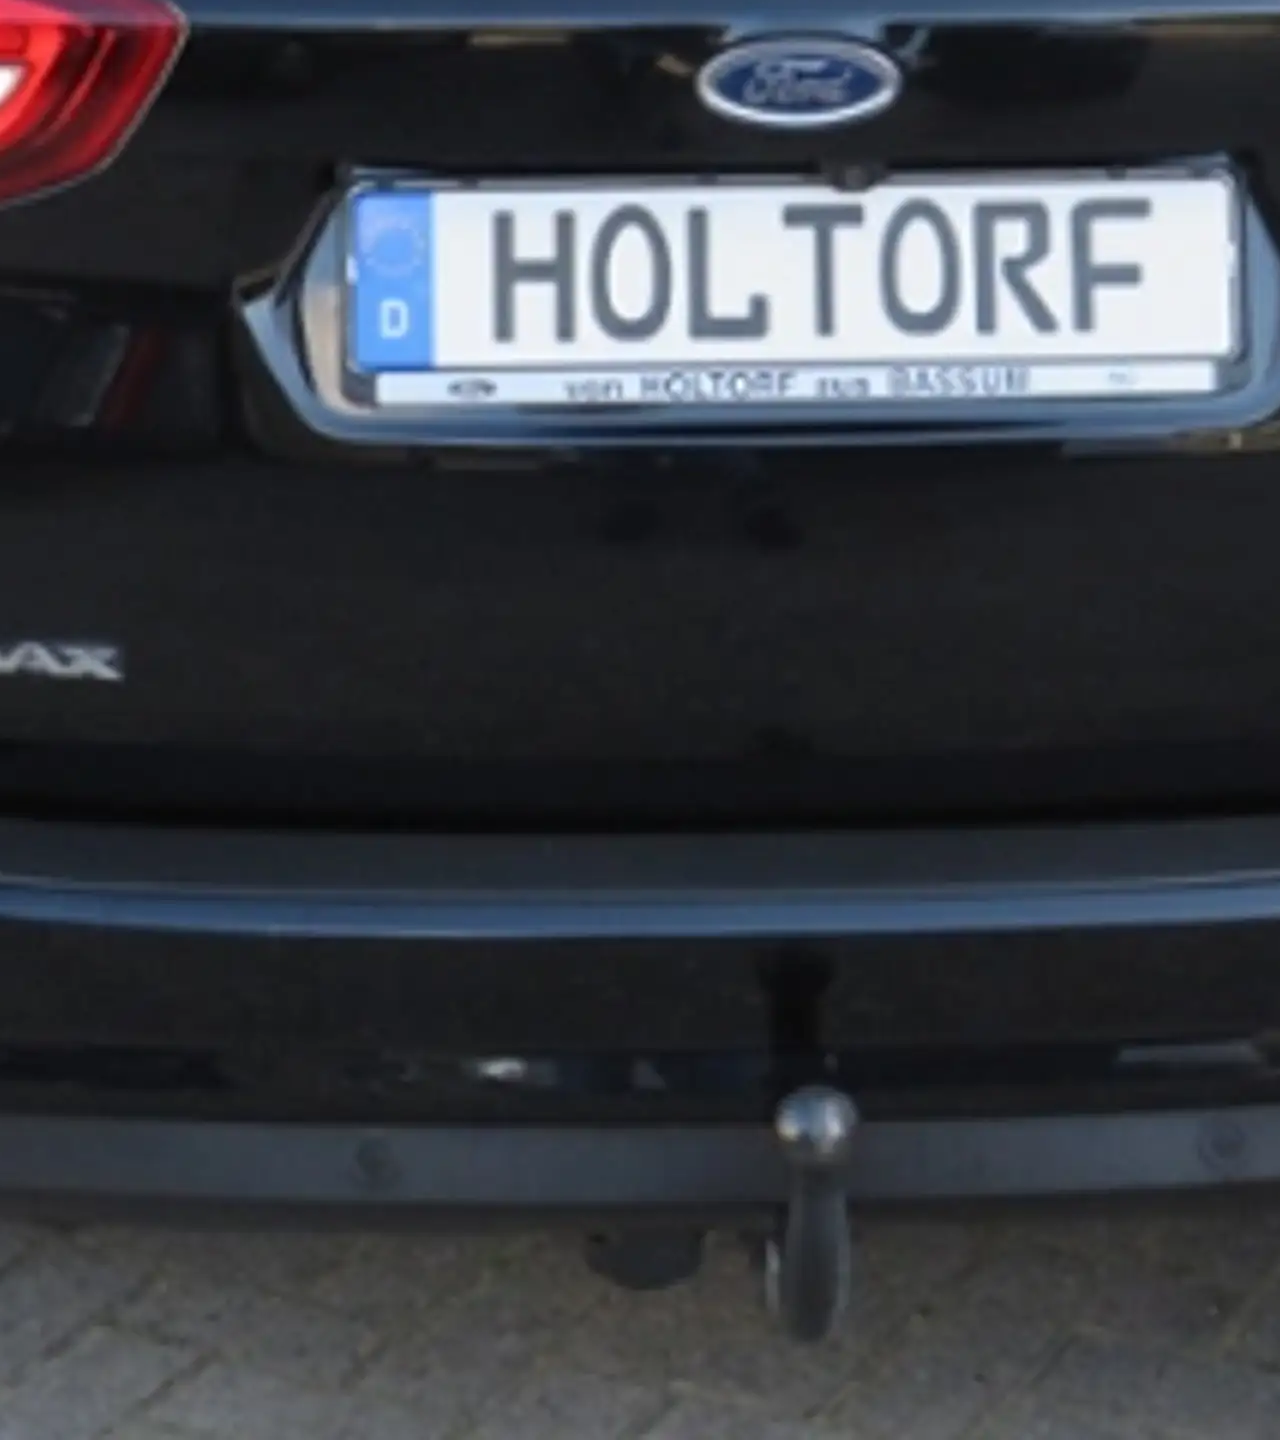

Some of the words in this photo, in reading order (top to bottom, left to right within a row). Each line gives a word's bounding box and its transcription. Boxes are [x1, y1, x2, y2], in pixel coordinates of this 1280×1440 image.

[742, 60, 853, 106] Ford
[380, 297, 409, 340] D
[492, 197, 1152, 343] HOLTORF
[564, 376, 625, 401] von
[638, 369, 799, 402] HOLTORF
